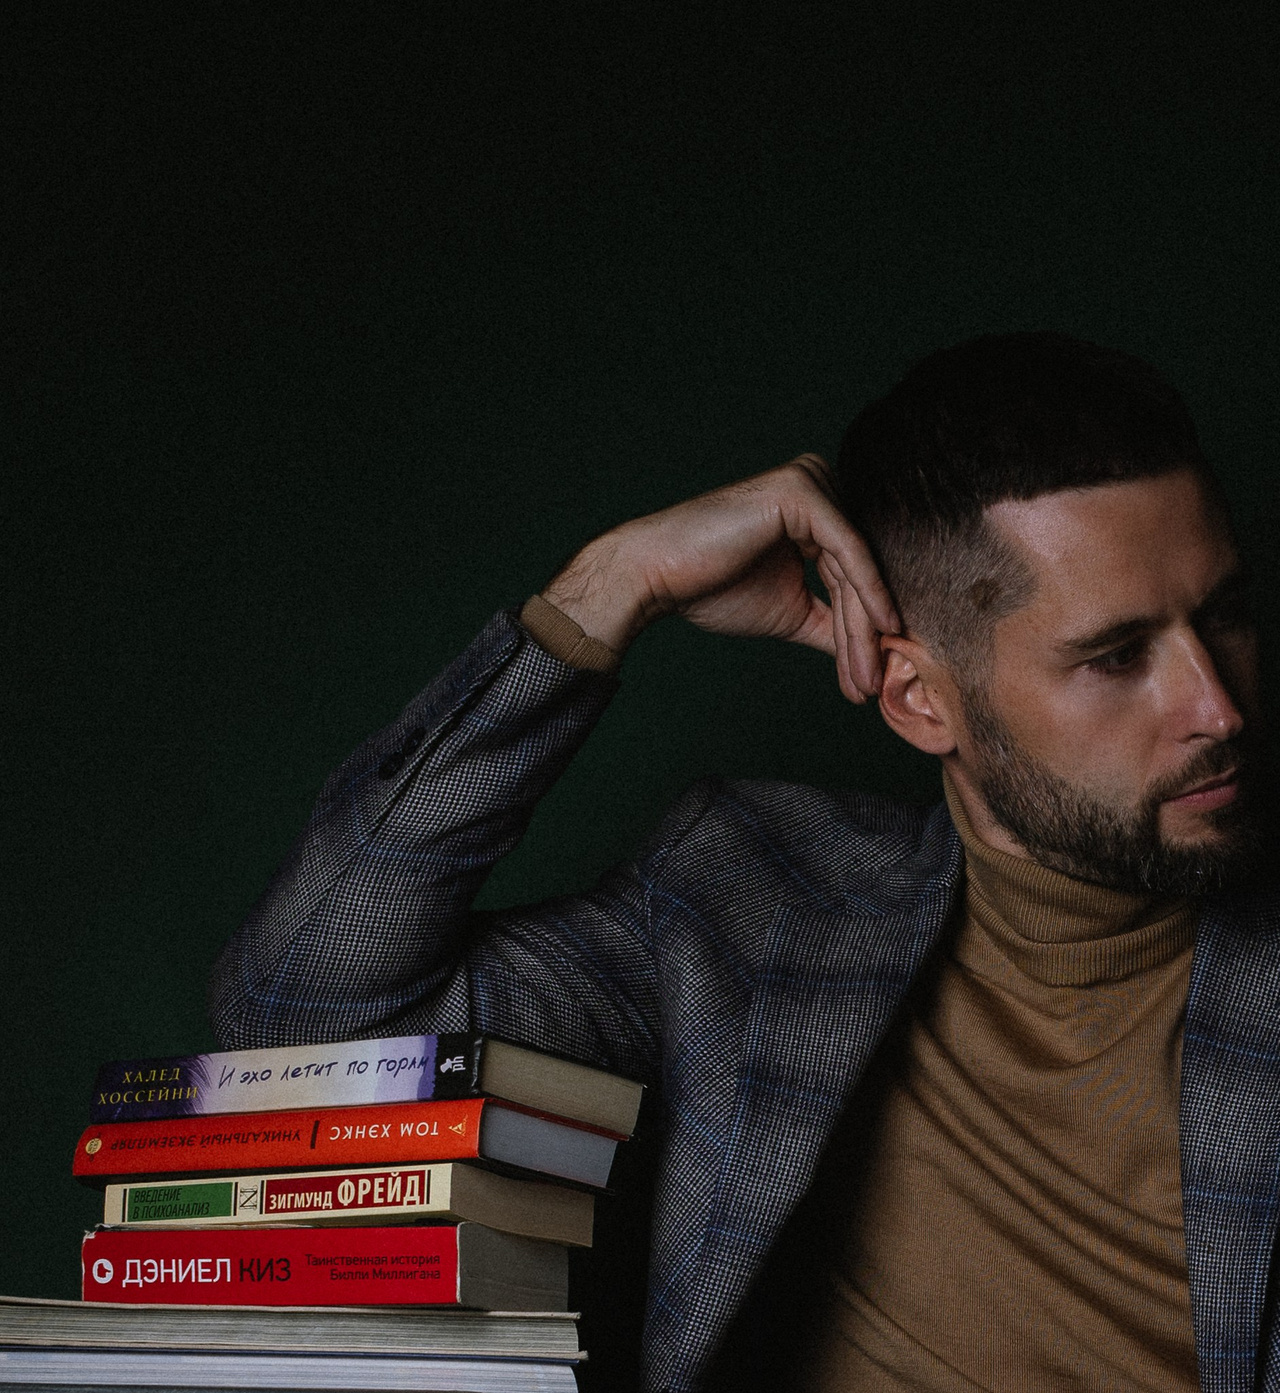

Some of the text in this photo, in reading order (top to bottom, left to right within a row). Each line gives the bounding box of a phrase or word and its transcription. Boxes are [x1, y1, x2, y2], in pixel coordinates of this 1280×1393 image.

[122, 1066, 181, 1085] ХАЛЕД
[219, 1056, 430, 1088] И эхо летит по горам
[98, 1084, 199, 1106] ХОССЕЙНИ
[111, 1127, 300, 1151] УНИКАЛЬНЫЙ ЭКЗЕМПЛЯР
[330, 1118, 438, 1141] ТОМ ХЭНКС
[134, 1187, 181, 1203] ВВЕДЕНИЕ
[269, 1171, 421, 1210] ЗИГМУНД ФРЕЙД
[142, 1200, 209, 1217] ПСИХОАНАЛИЗ
[306, 1252, 440, 1268] Таинственная история
[122, 1257, 291, 1288] ДЭНИЕЛ КИЗ
[330, 1266, 441, 1282] Билли Миллигана
